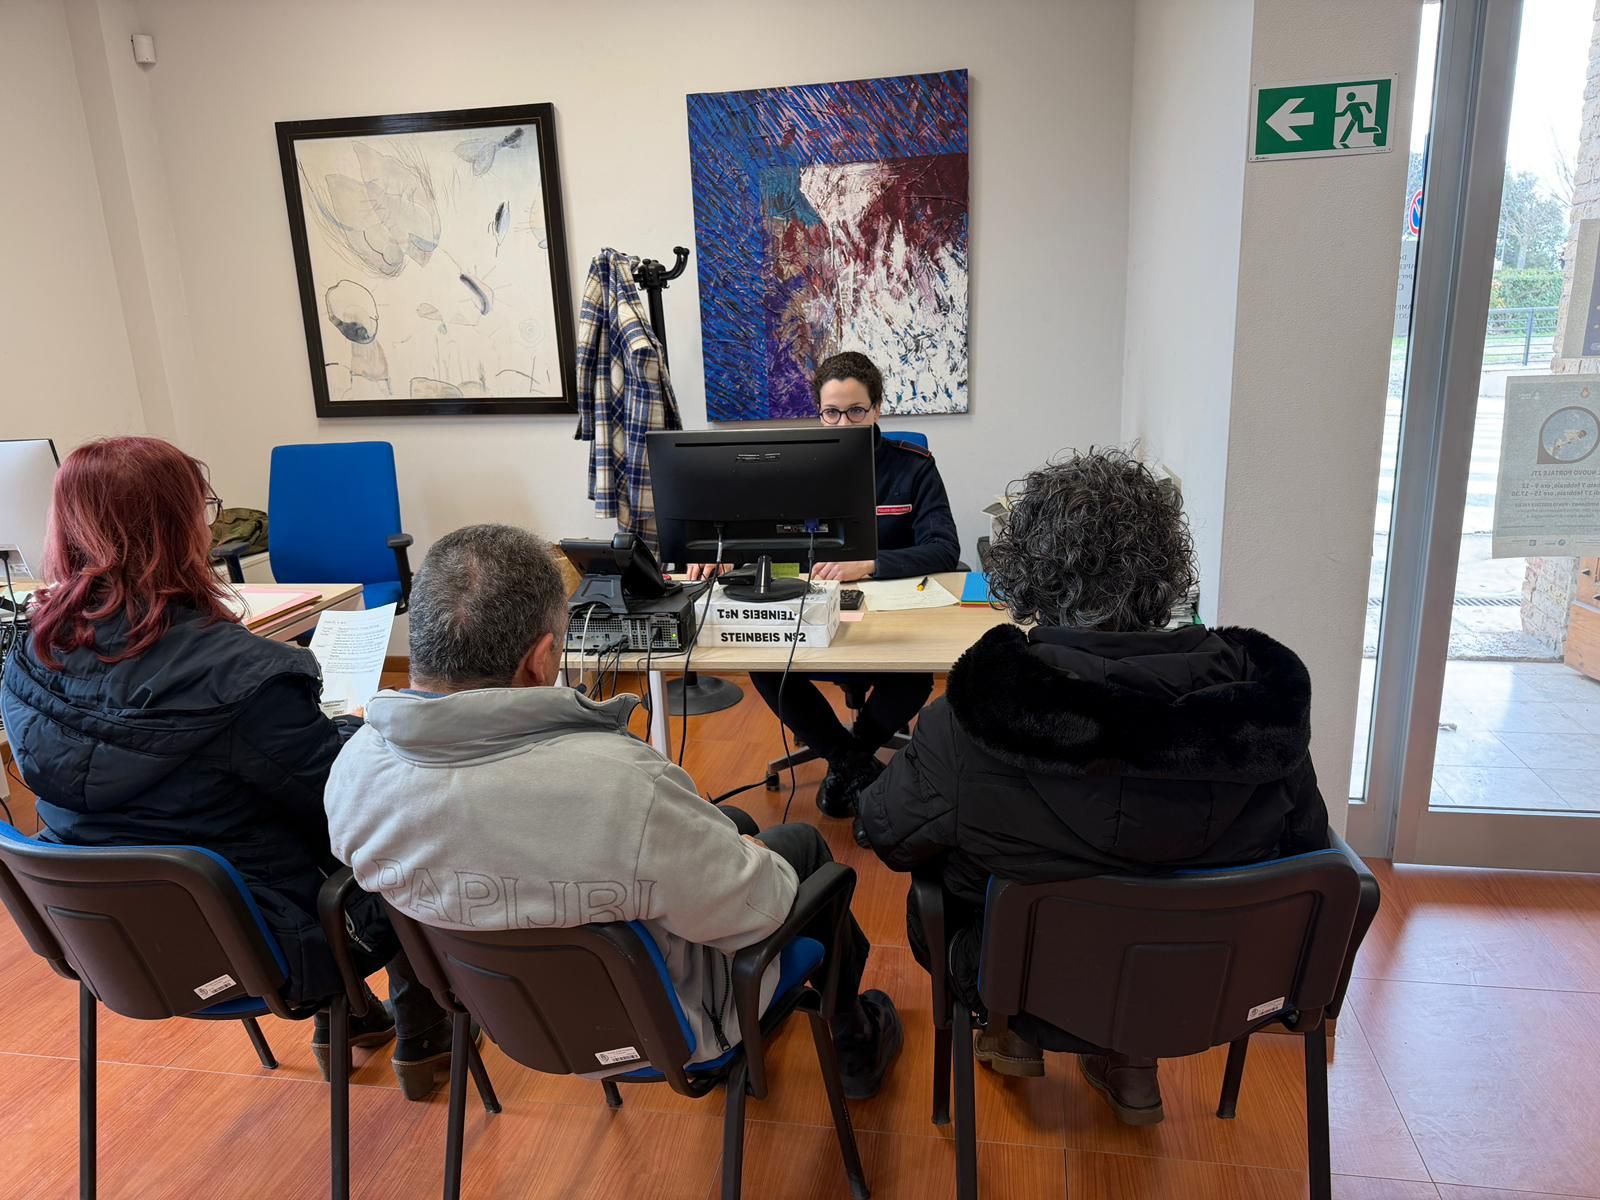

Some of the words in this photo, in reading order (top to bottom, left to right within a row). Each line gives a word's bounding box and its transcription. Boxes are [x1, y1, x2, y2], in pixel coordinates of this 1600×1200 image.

[743, 609, 797, 621] TEINBEIS
[720, 632, 780, 642] STEINBEIS
[366, 859, 657, 928] PAPIJRI
